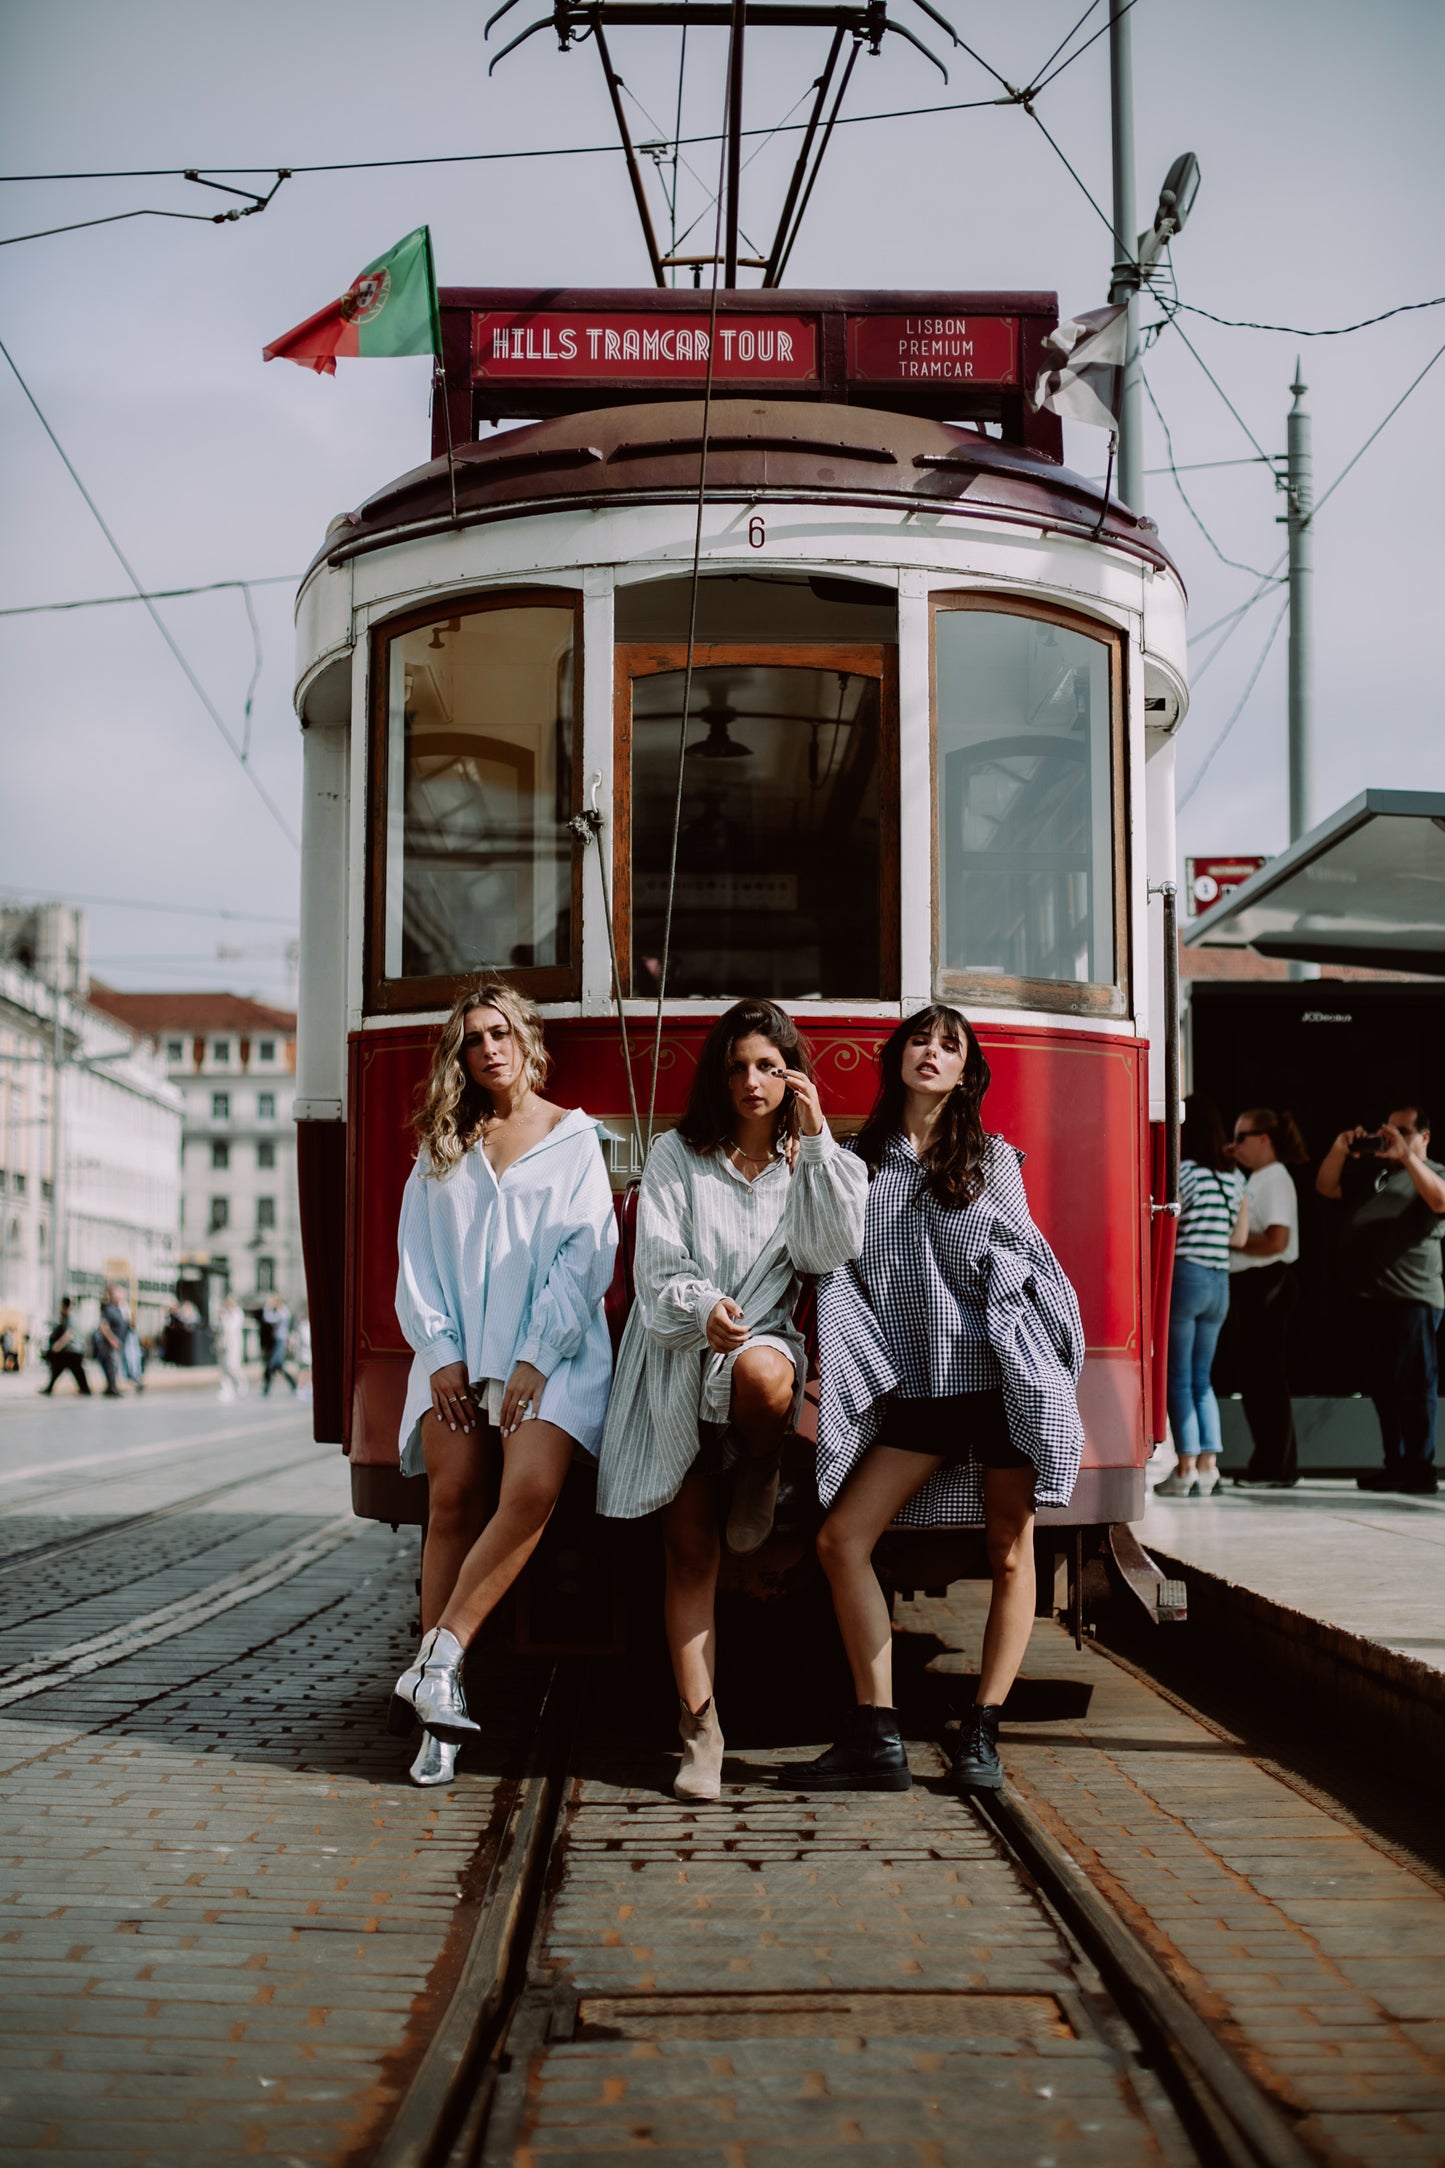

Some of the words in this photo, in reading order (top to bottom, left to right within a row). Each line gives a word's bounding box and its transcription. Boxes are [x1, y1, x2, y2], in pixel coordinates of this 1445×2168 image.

[906, 319, 966, 335] LISBON
[493, 328, 577, 359] HILLS
[586, 328, 709, 360] TRAMCAR
[720, 329, 794, 362] TOUR
[899, 340, 974, 356] PREMIUM
[899, 361, 974, 377] TRAMCAR
[749, 516, 765, 549] 6
